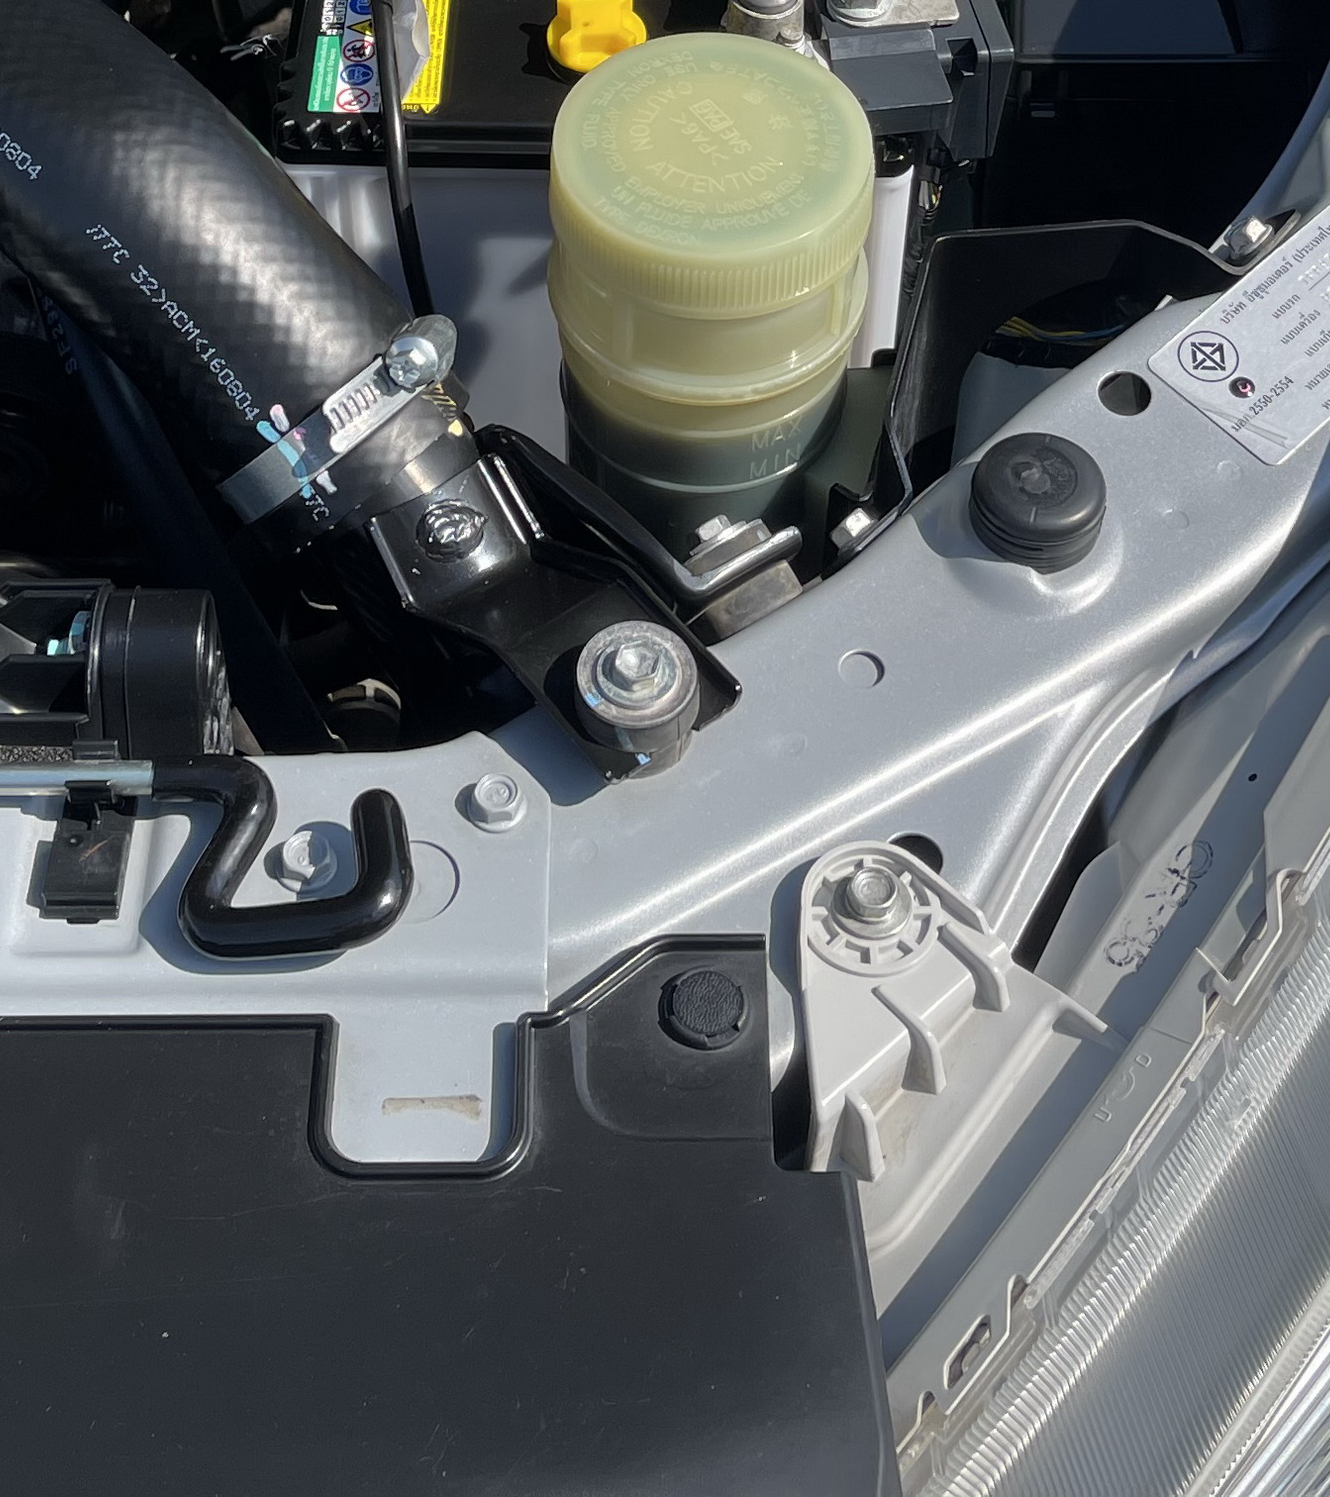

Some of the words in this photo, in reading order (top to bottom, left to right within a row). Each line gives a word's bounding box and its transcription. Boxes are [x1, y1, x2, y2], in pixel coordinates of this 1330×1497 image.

[630, 80, 693, 153] CAUTION
[721, 127, 752, 154] SAE
[644, 156, 781, 193] ATTENTION
[624, 176, 707, 213] EMPLOYER
[750, 417, 801, 453] MAX
[749, 443, 802, 480] MIN
